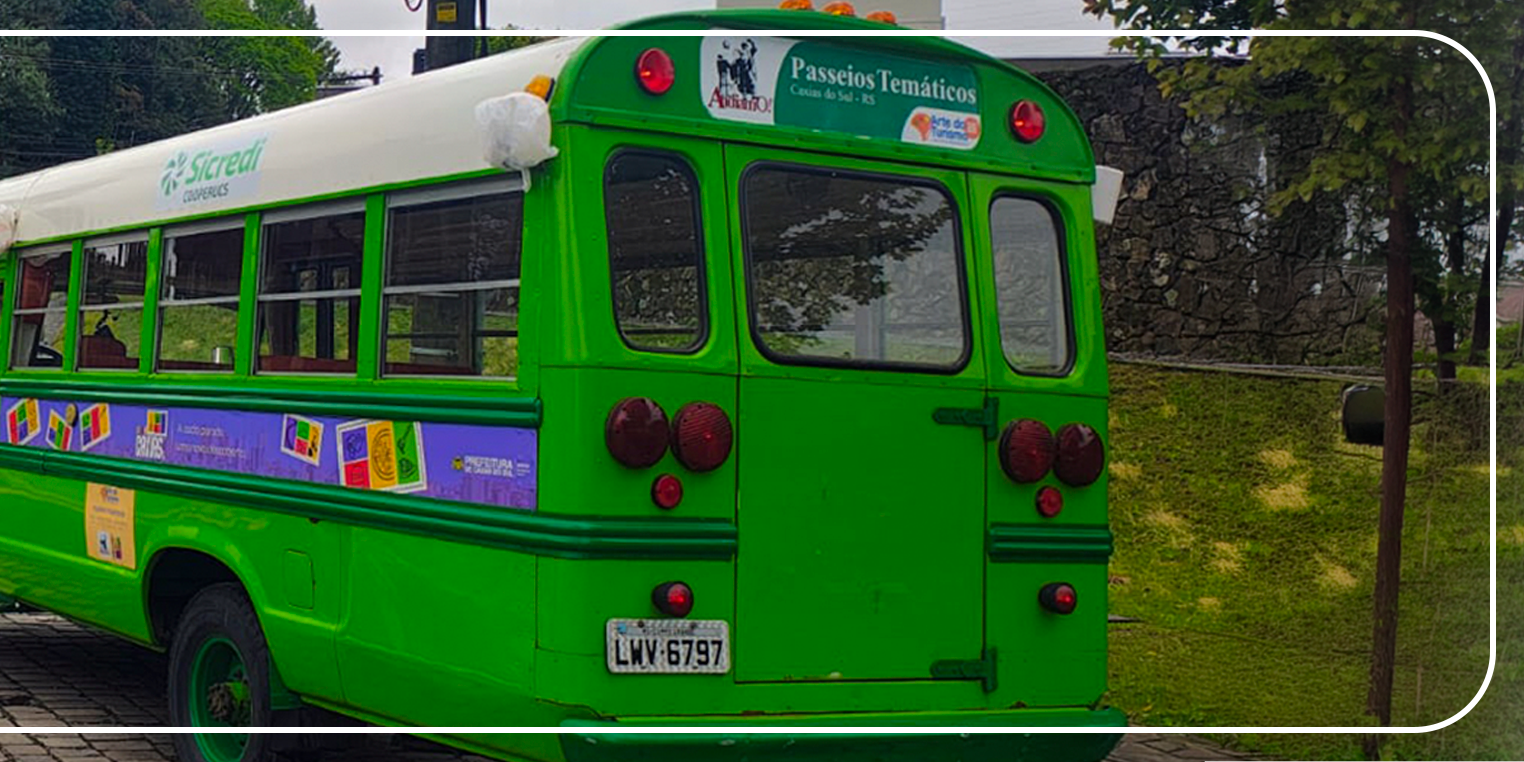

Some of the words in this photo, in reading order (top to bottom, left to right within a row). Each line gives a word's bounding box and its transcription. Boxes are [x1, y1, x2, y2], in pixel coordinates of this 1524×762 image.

[790, 84, 821, 98] Caxias
[826, 88, 836, 100] do
[838, 90, 853, 102] Sul
[862, 93, 875, 105] RS
[791, 56, 875, 90] Passeios
[877, 68, 977, 105] Temáticos
[185, 137, 266, 185] Sicredi
[464, 456, 513, 469] PREFEITURA
